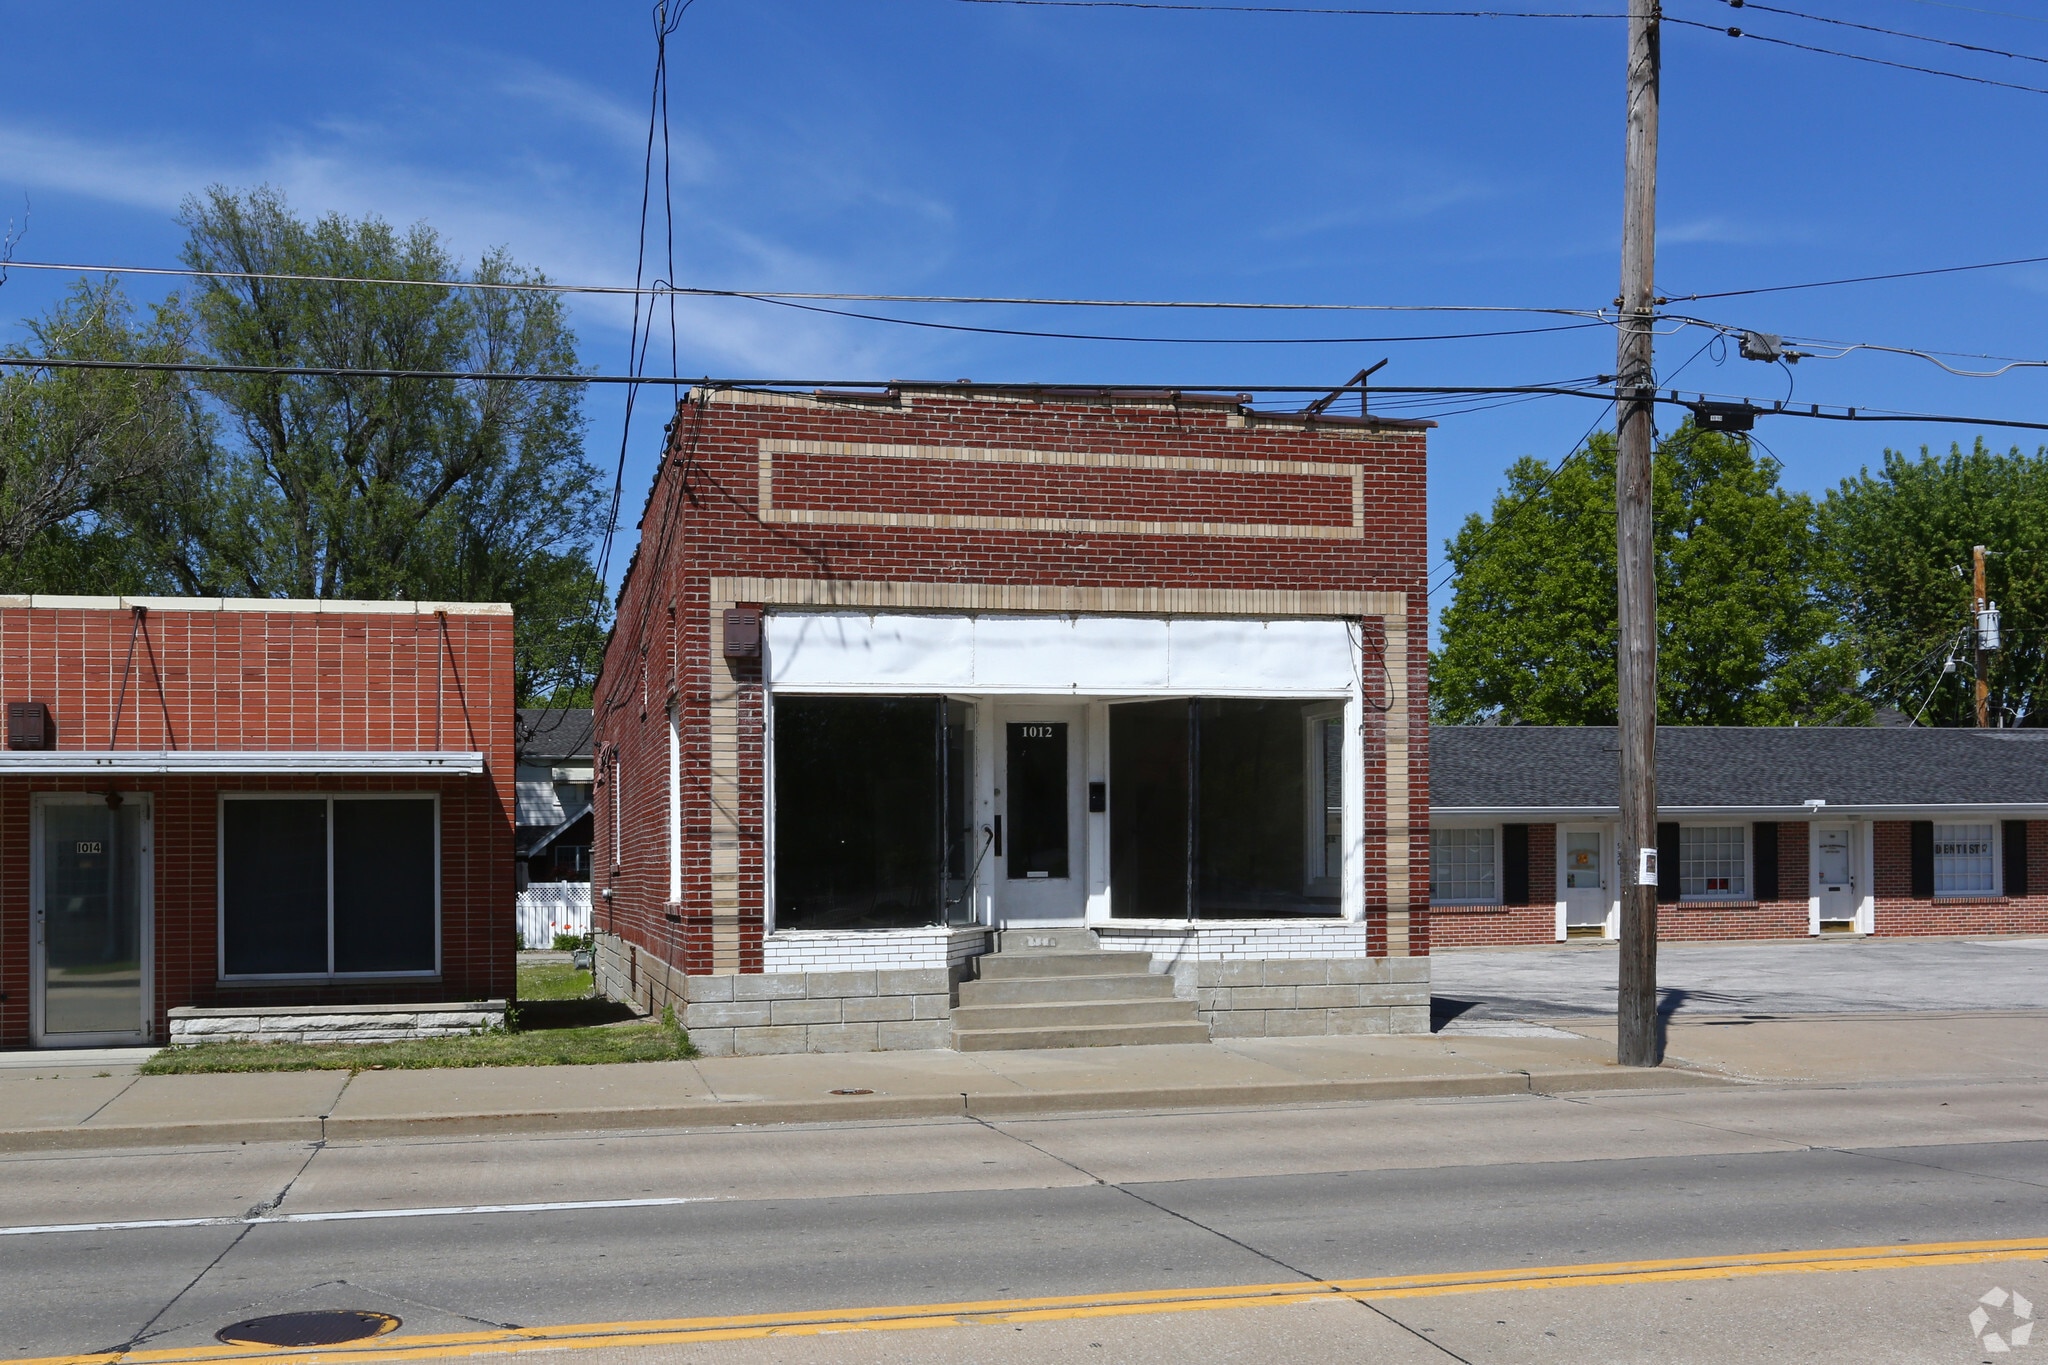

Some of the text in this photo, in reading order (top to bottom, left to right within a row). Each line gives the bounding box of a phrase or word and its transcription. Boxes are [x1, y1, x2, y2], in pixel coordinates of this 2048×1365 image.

[1022, 726, 1053, 738] 1012
[77, 842, 101, 853] 1014
[1935, 843, 1980, 854] DENTIST
